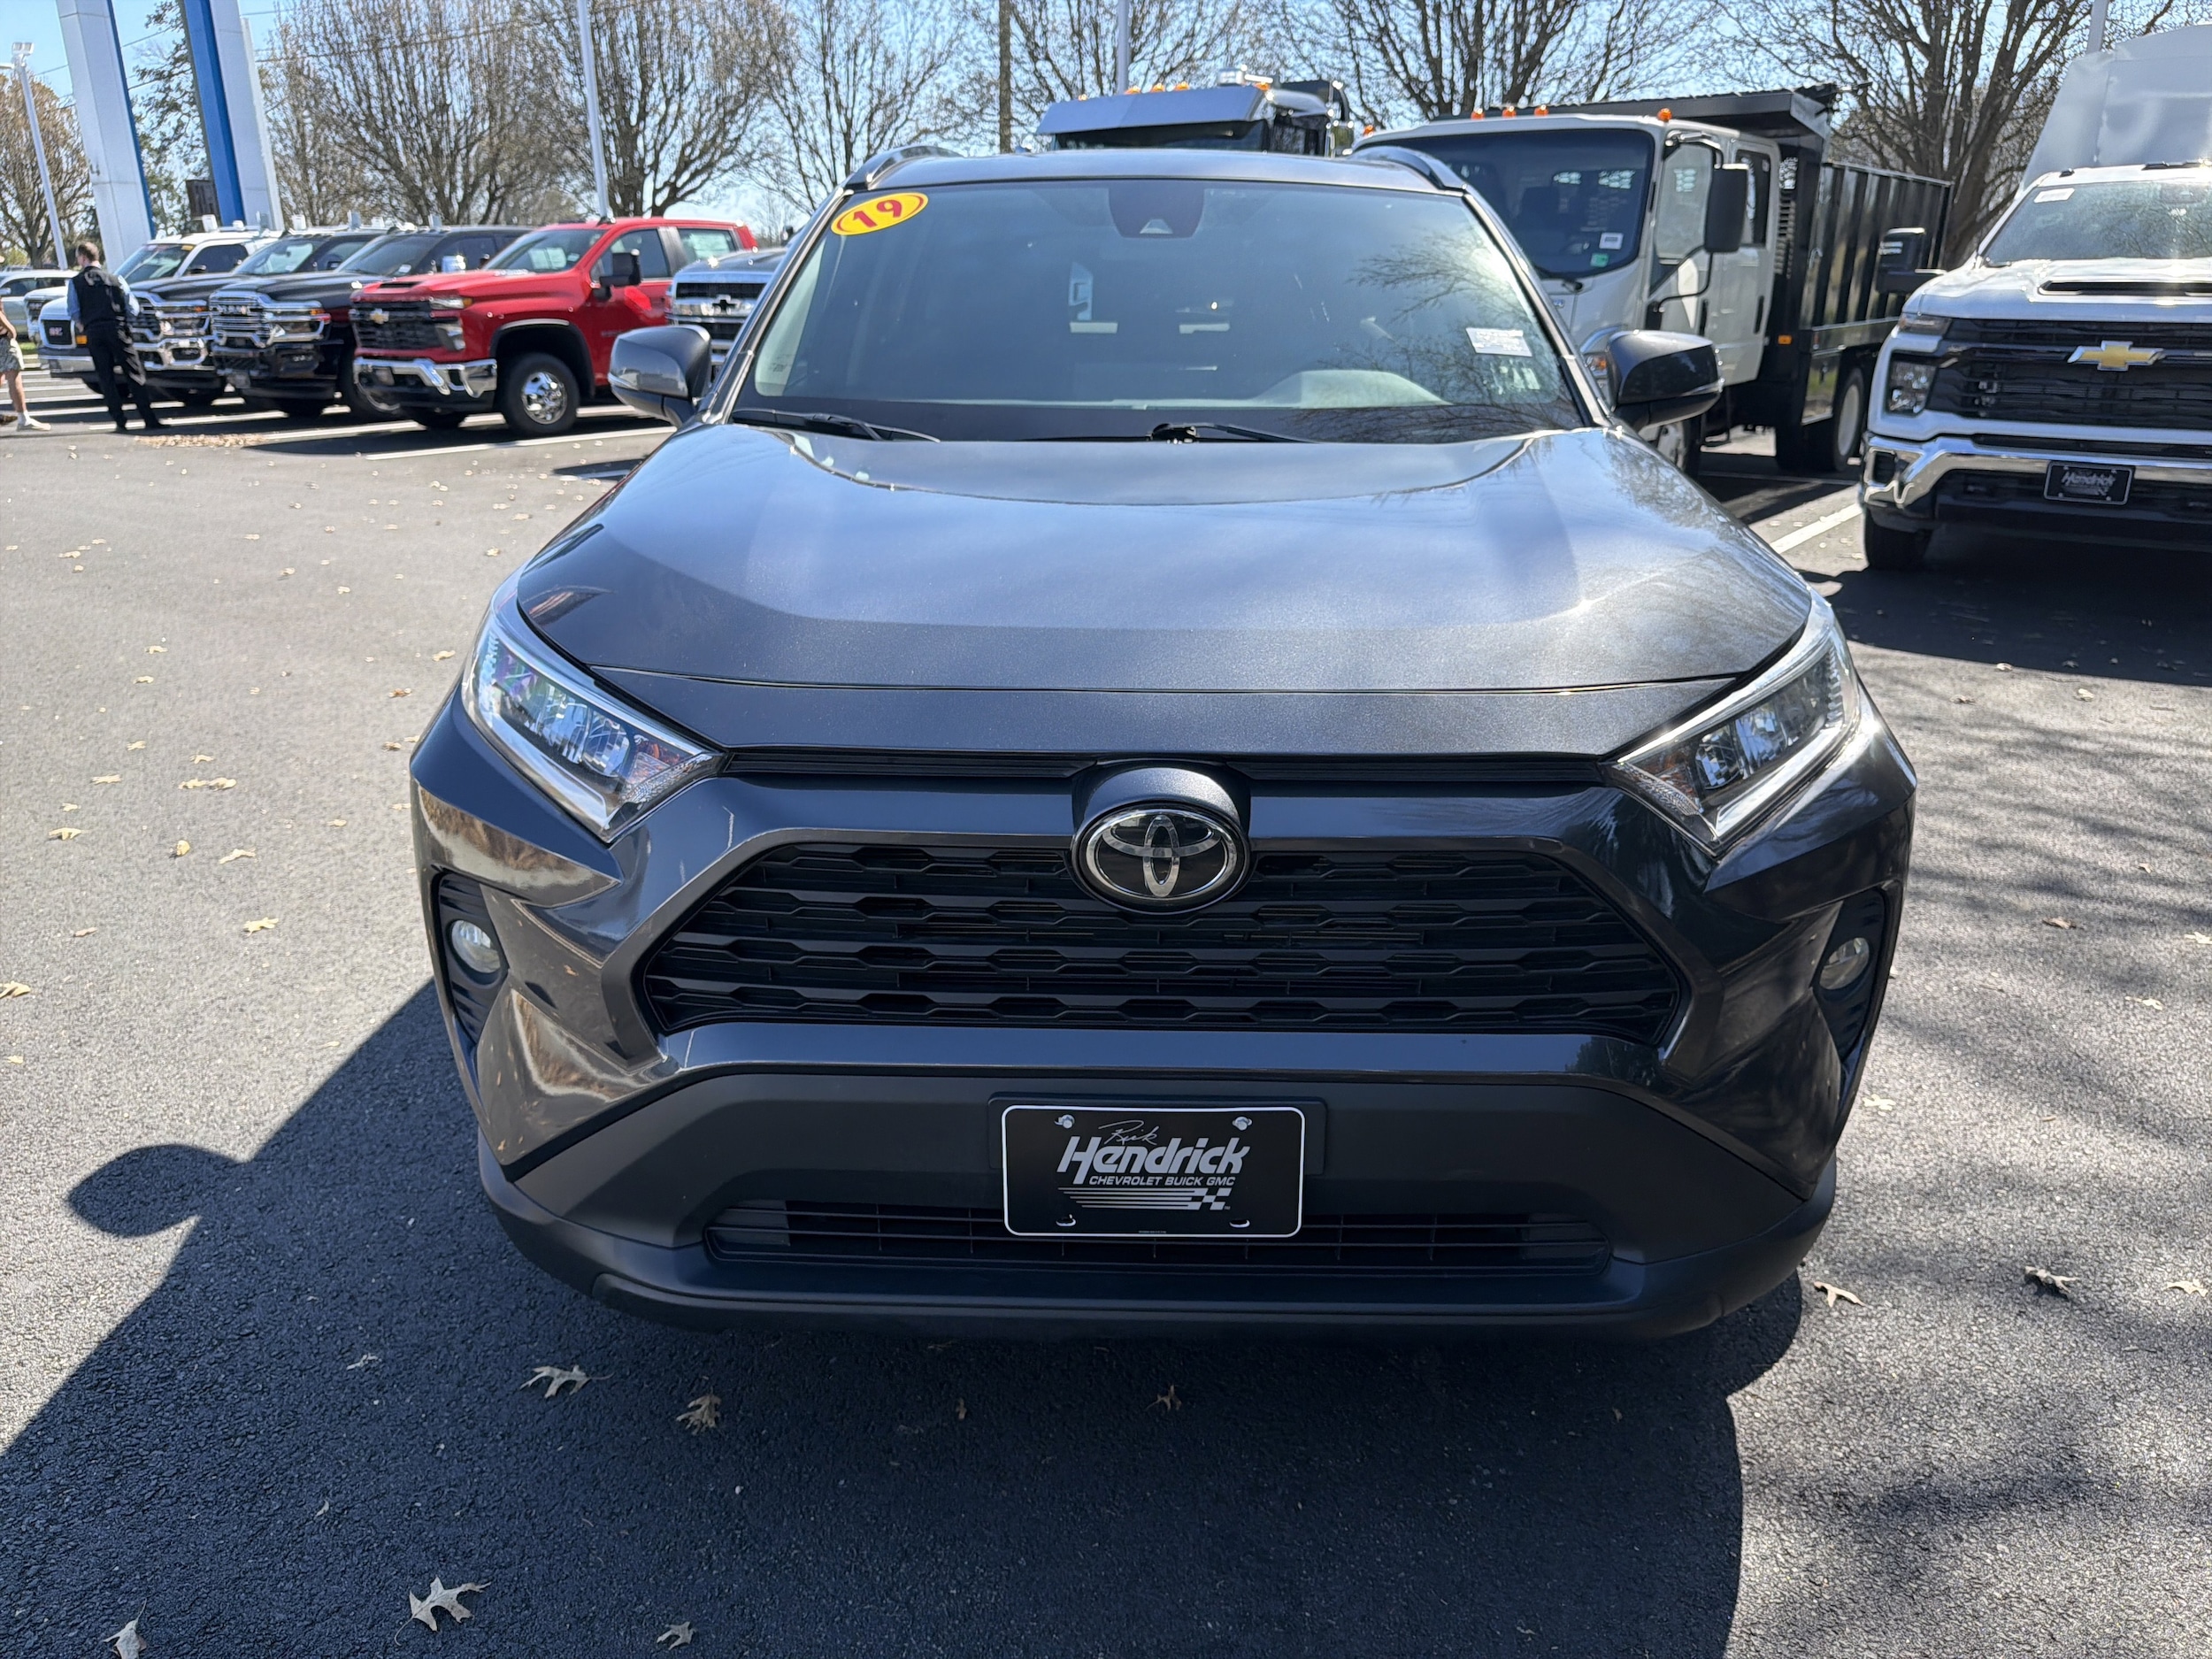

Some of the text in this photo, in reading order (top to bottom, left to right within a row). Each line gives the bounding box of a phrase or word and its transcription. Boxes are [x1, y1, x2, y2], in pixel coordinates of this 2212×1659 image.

[852, 199, 902, 228] 19
[1056, 1136, 1251, 1185] Hendrick
[1088, 1175, 1236, 1187] CHEVROLET BUICK GMC
